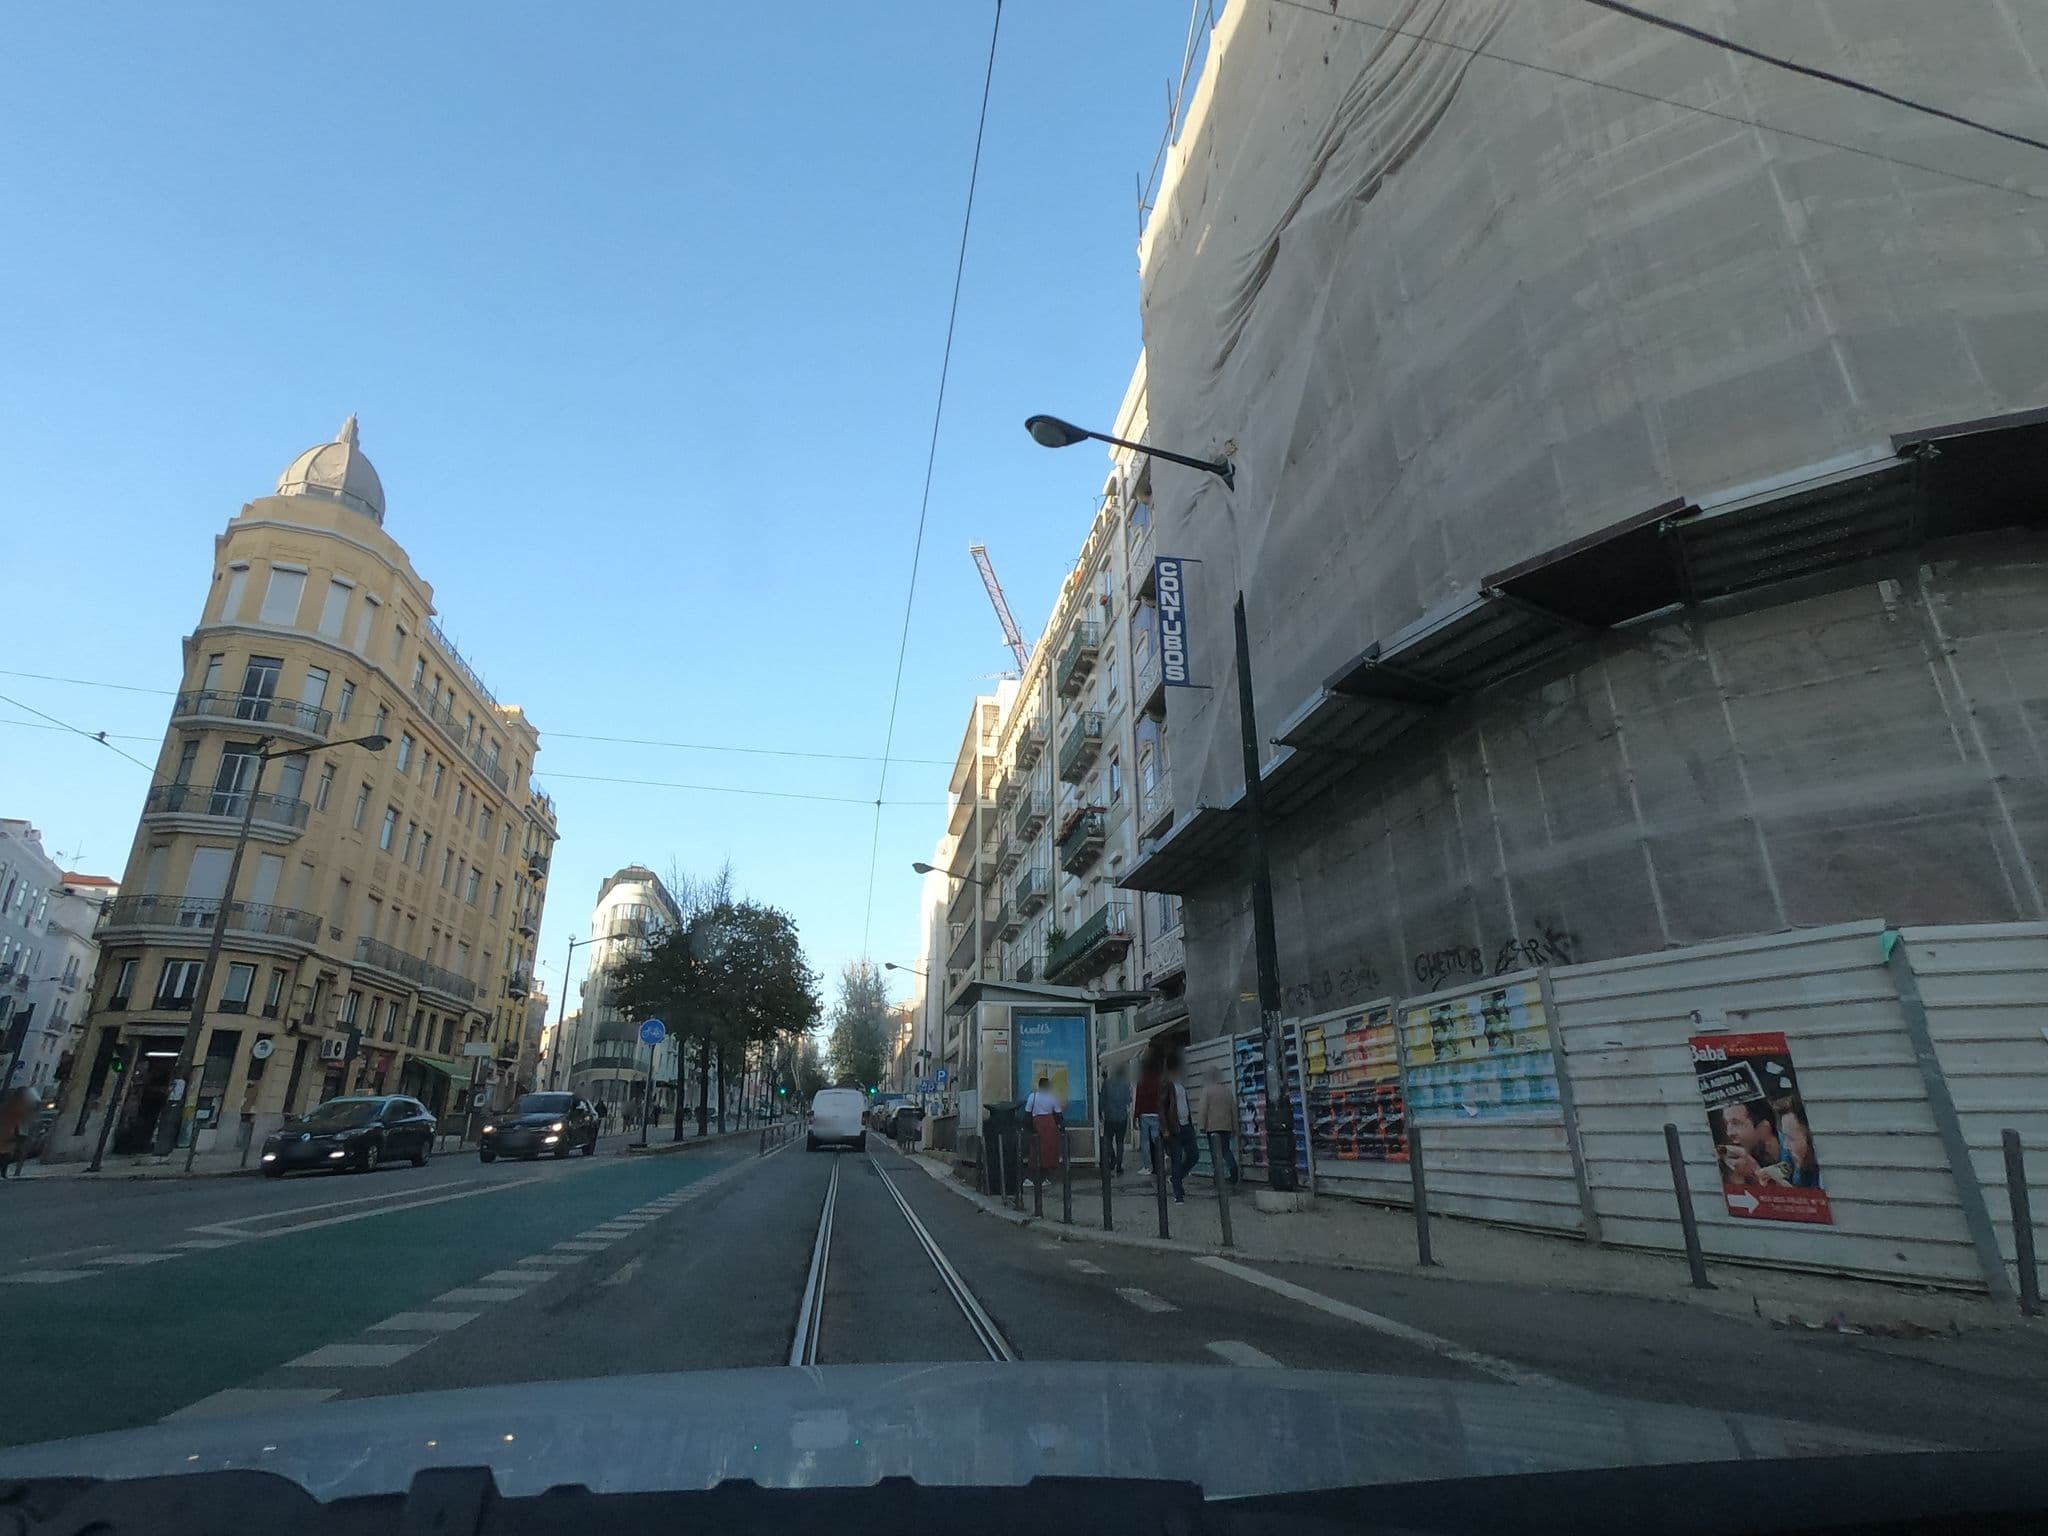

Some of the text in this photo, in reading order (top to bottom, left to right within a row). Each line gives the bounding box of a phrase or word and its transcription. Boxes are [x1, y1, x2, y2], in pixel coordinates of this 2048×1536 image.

[1159, 562, 1185, 682] CONTUBOS
[1689, 1044, 1727, 1062] Baba
[938, 1070, 946, 1081] P
